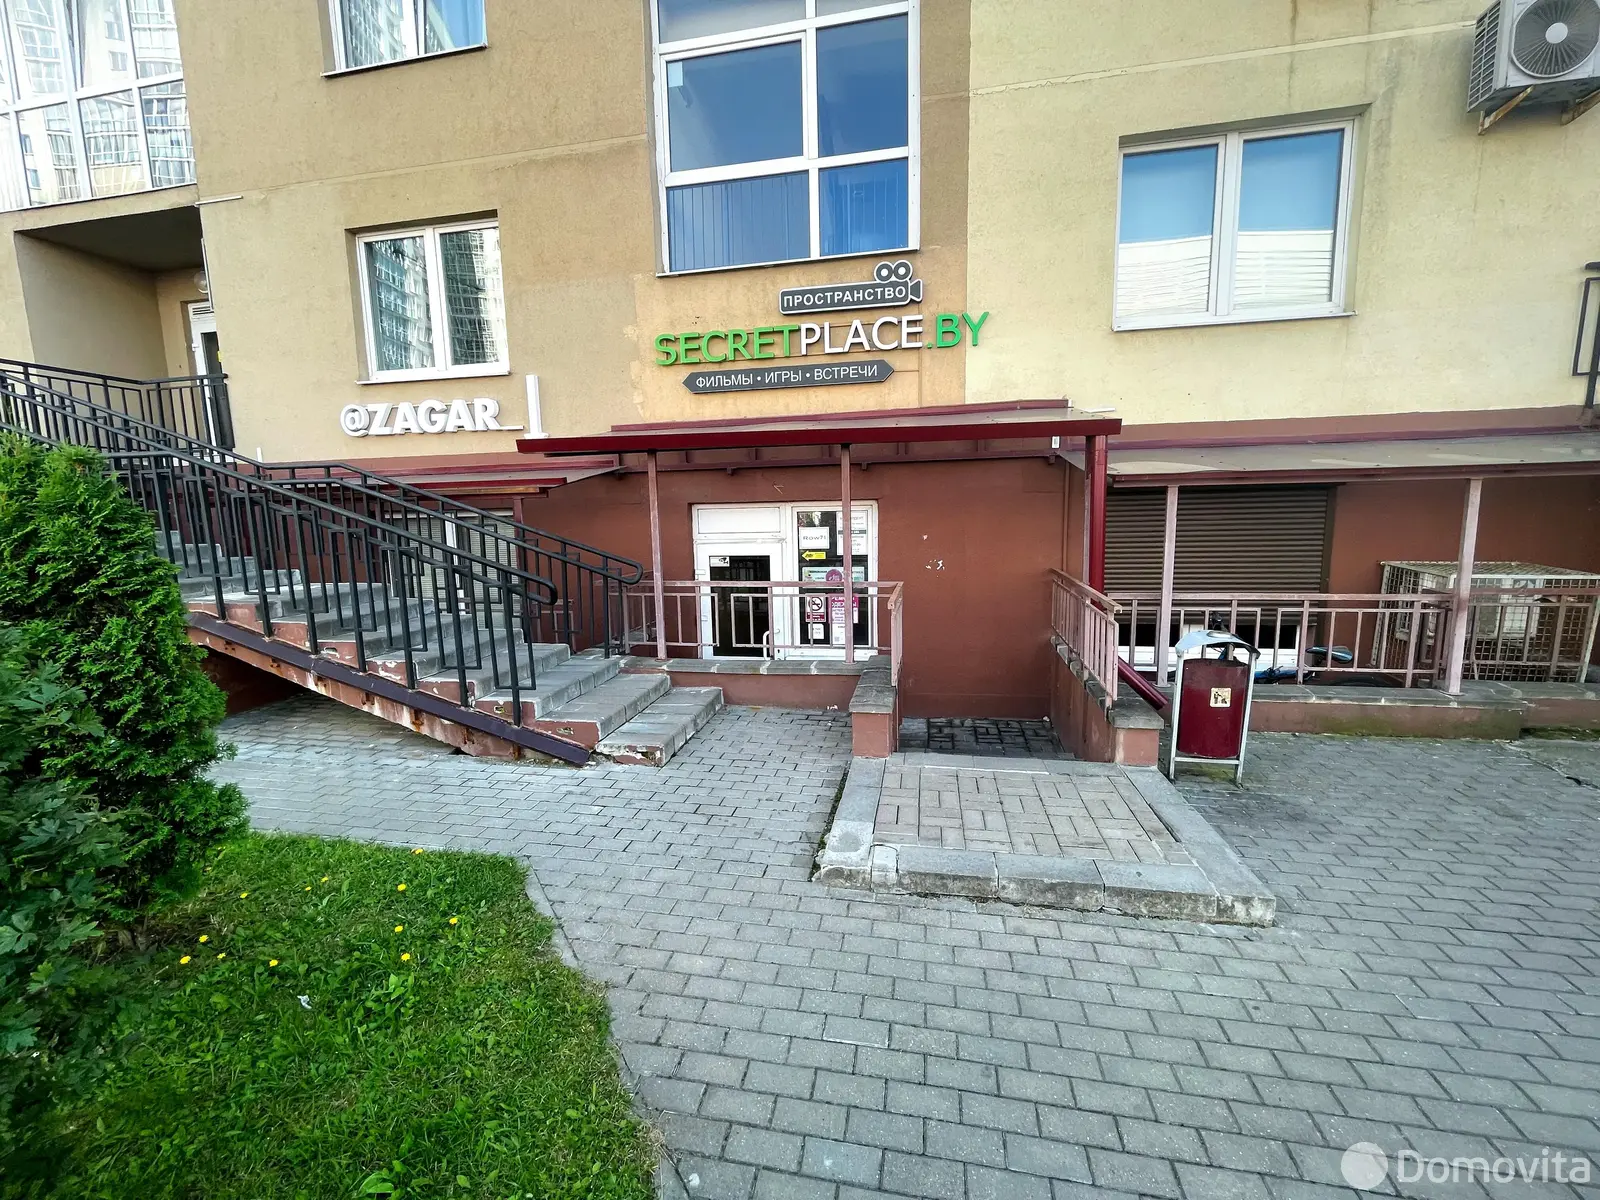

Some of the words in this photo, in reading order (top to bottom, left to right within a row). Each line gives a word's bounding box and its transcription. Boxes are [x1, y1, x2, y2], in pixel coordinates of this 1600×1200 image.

[783, 285, 906, 308] ПРОСТРАНСТВО
[654, 311, 990, 367] SECRETPLACE.BY
[695, 373, 753, 389] ФИЛЬМЫ
[765, 370, 802, 385] ИГРЫ
[814, 364, 878, 381] ВСТРЕЧИ
